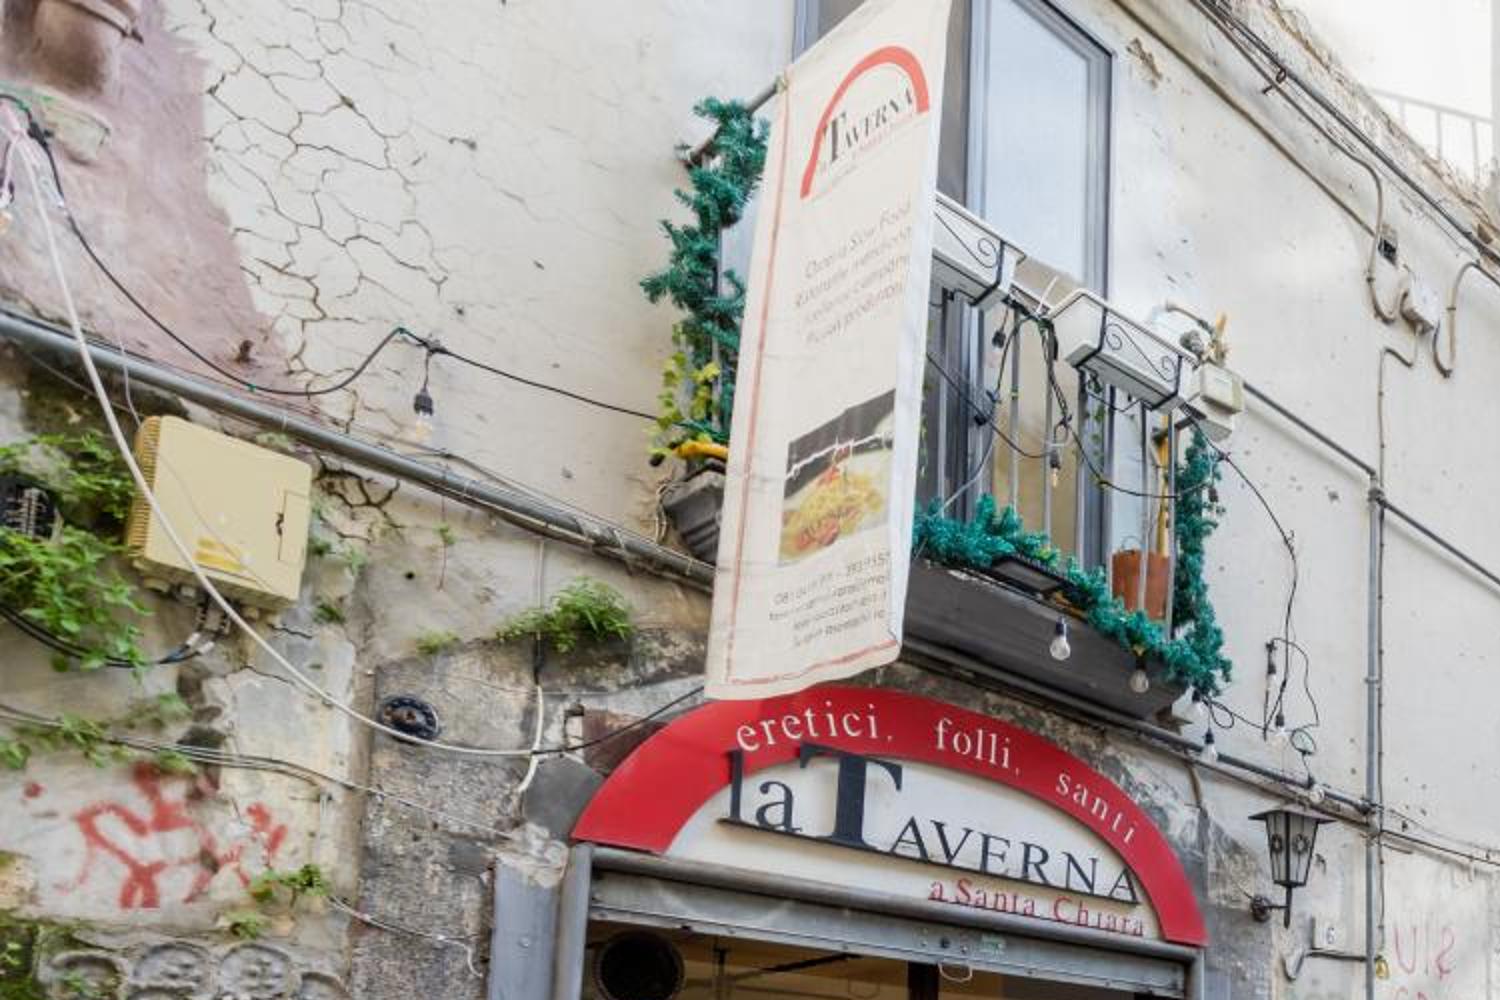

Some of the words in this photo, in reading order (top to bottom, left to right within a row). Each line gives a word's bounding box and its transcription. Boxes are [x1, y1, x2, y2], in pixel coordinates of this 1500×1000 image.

[1055, 771, 1138, 845] santi
[954, 877, 1036, 917] Santa
[1053, 894, 1145, 937] Chiara
